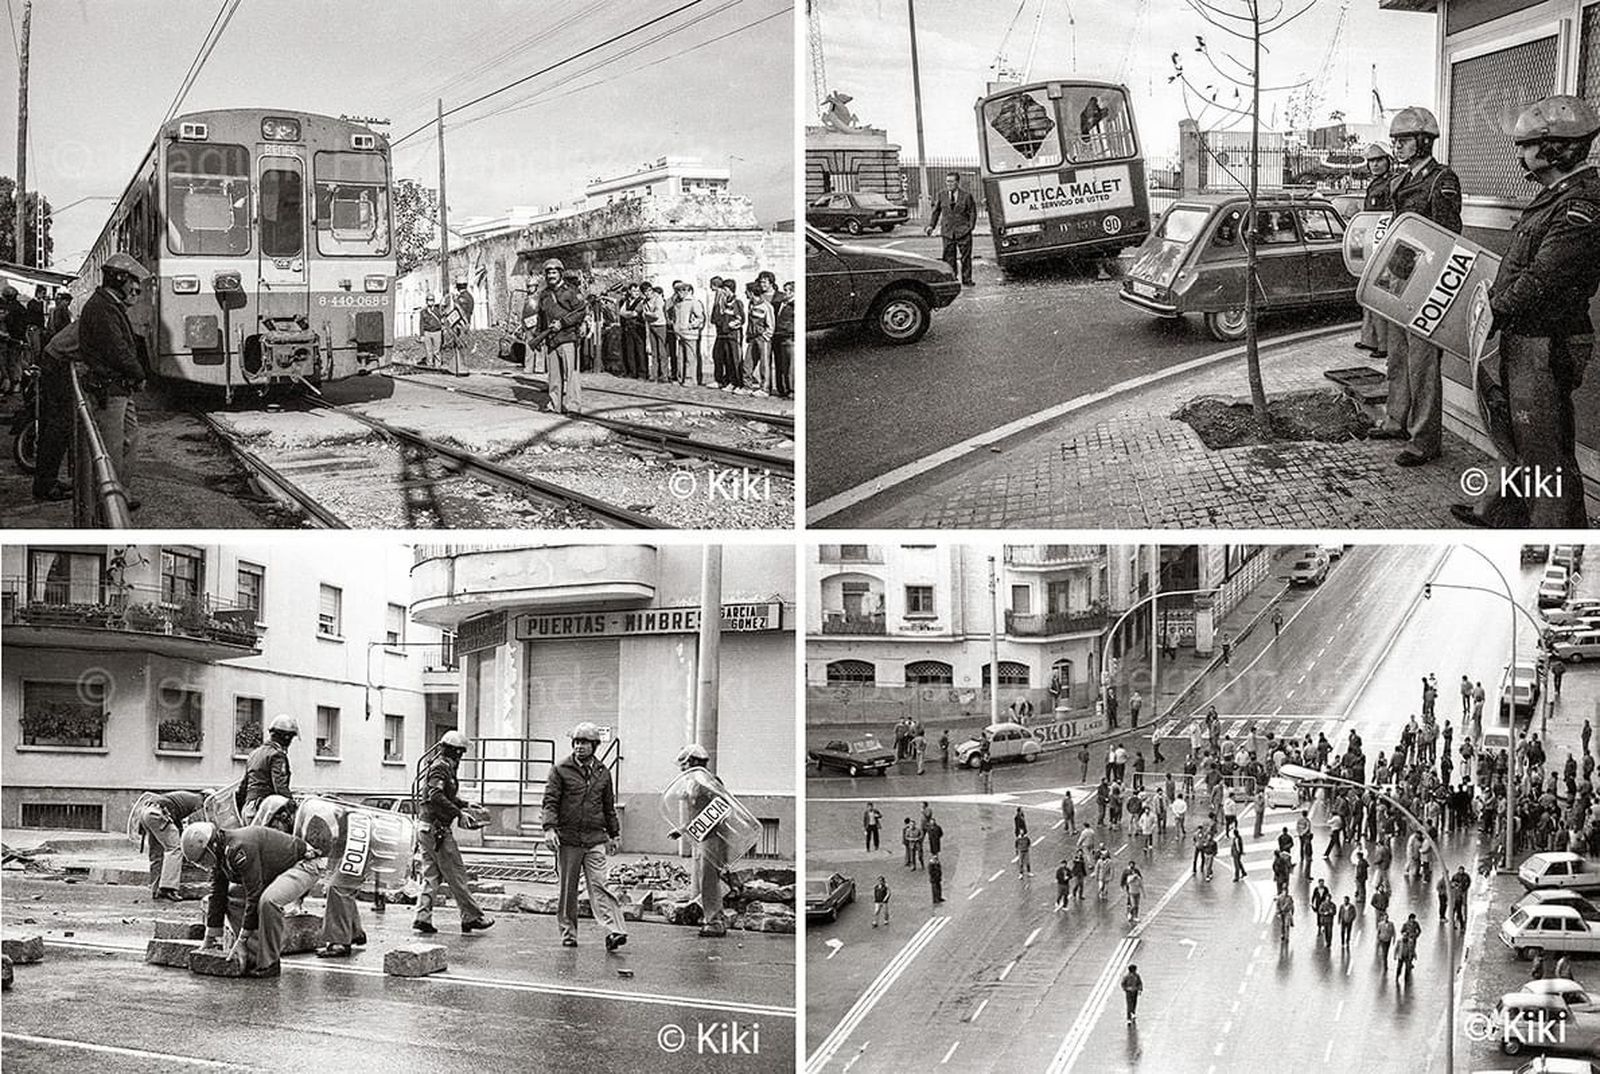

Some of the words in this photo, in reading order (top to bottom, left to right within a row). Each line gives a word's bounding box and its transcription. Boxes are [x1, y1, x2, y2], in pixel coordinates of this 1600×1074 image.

[1009, 187, 1067, 205] OPTICA
[1069, 179, 1122, 198] MALET
[1029, 203, 1040, 211] AL
[1041, 198, 1073, 209] SERVICIO
[1075, 197, 1085, 205] DE
[1086, 194, 1110, 203] USTED
[1104, 218, 1119, 232] 90
[1412, 253, 1474, 333] POLICIA
[527, 615, 606, 636] PUERTAS
[731, 617, 766, 630] GOMEZ
[1033, 721, 1082, 744] SKOL
[689, 799, 729, 839] POLICIA
[341, 815, 368, 875] POLICIA
